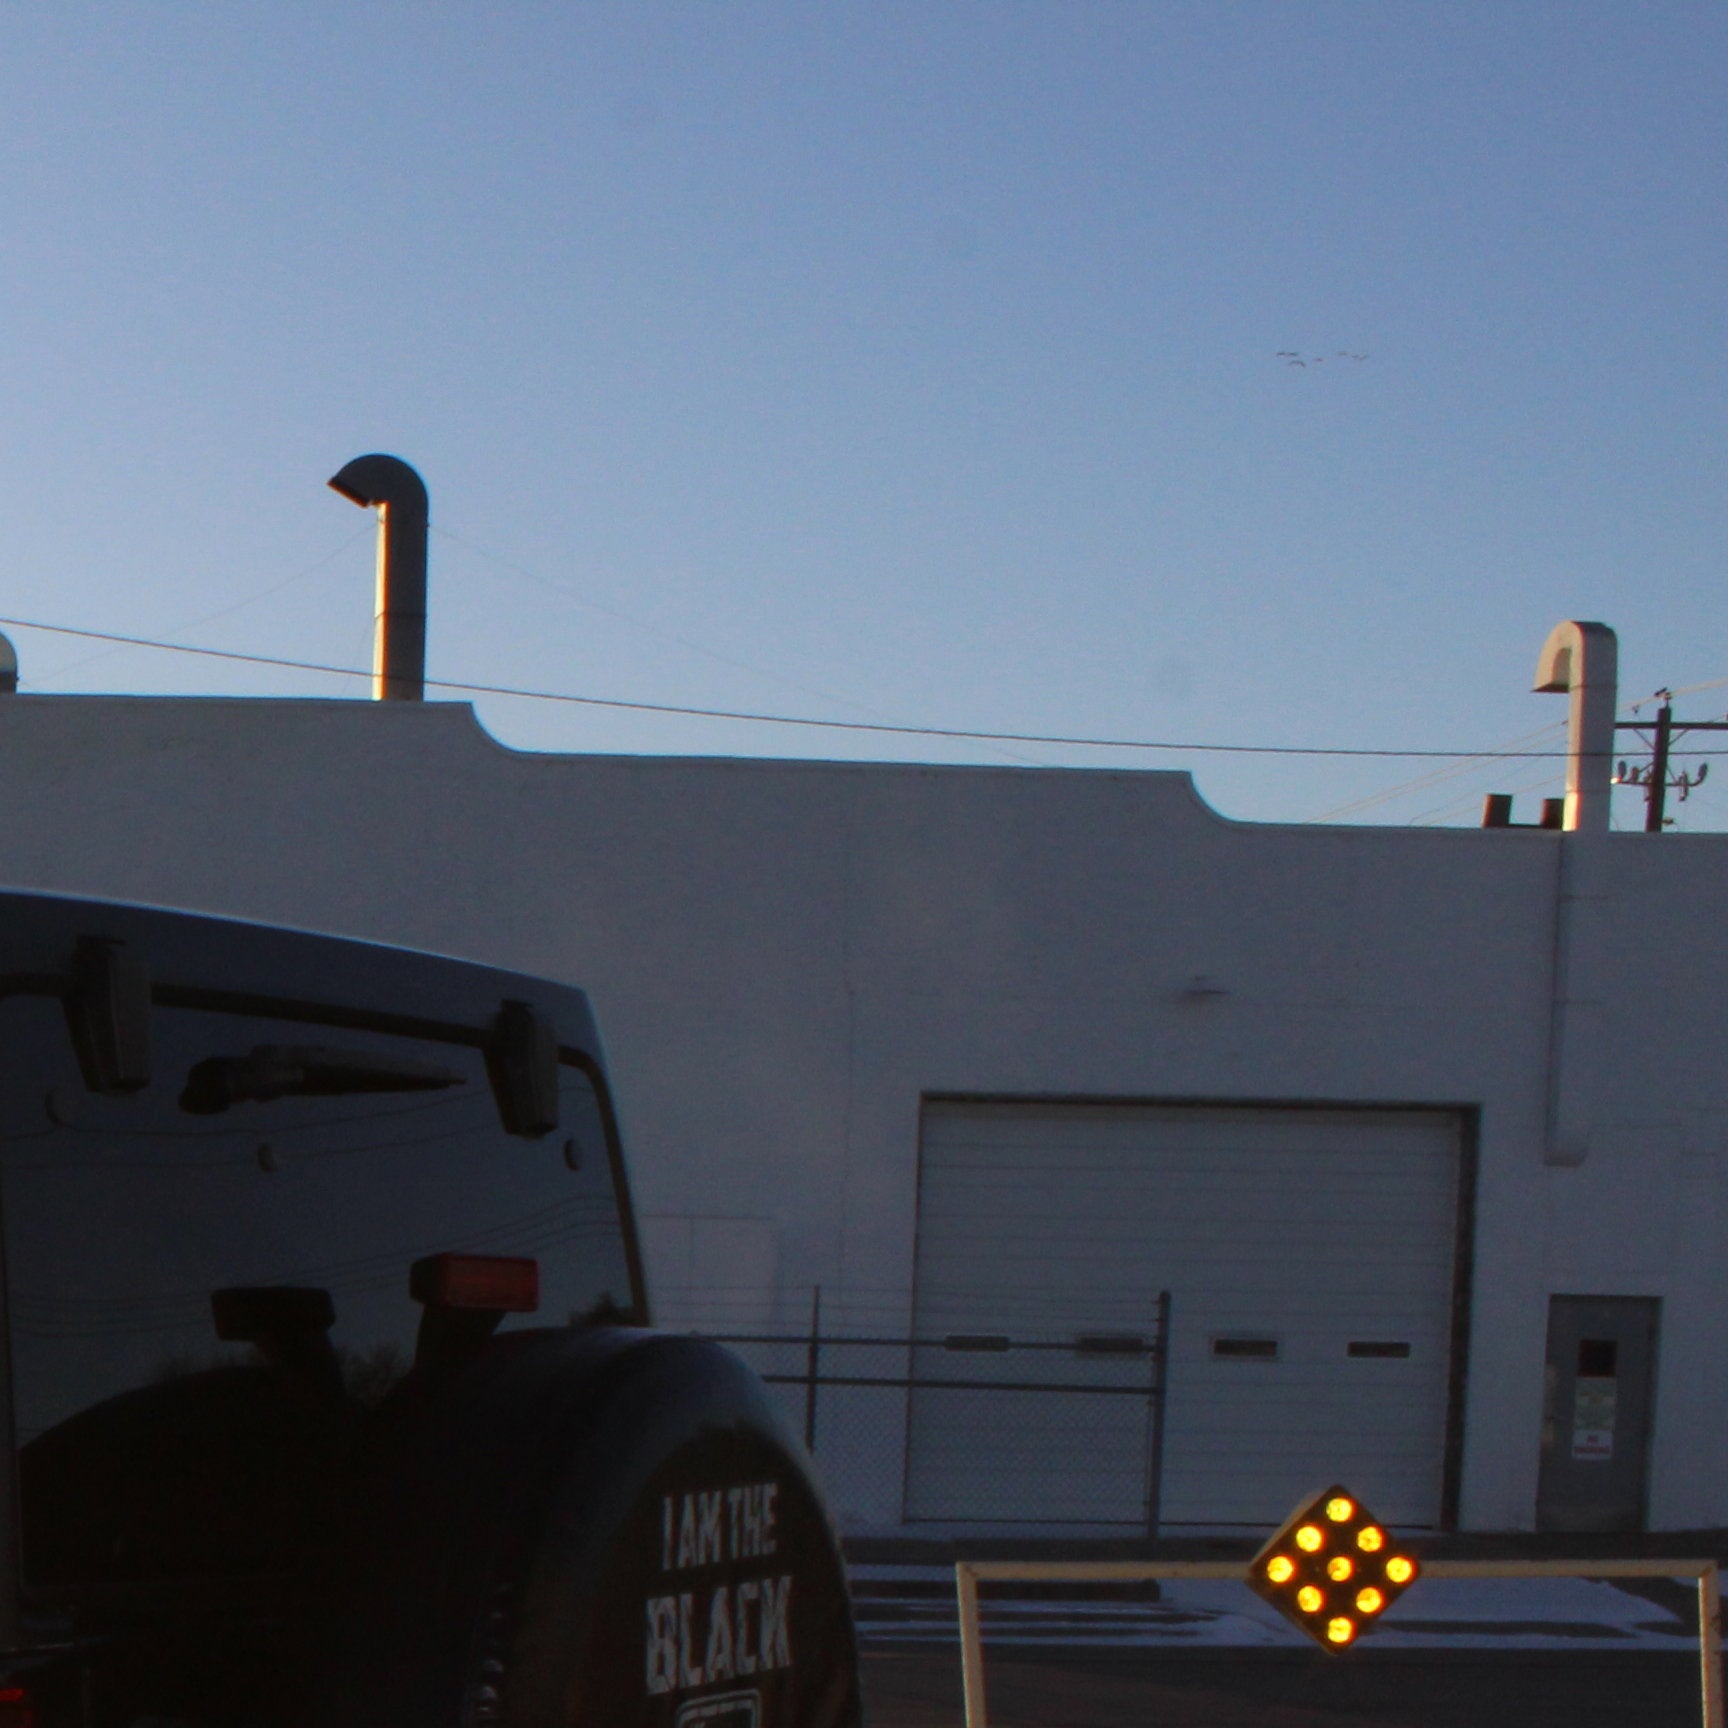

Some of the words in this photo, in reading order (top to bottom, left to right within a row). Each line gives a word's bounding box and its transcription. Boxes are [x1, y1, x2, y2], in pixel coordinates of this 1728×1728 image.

[662, 1496, 673, 1571] I
[677, 1489, 723, 1570] AM
[727, 1483, 778, 1559] THE
[646, 1574, 792, 1696] BLACK
